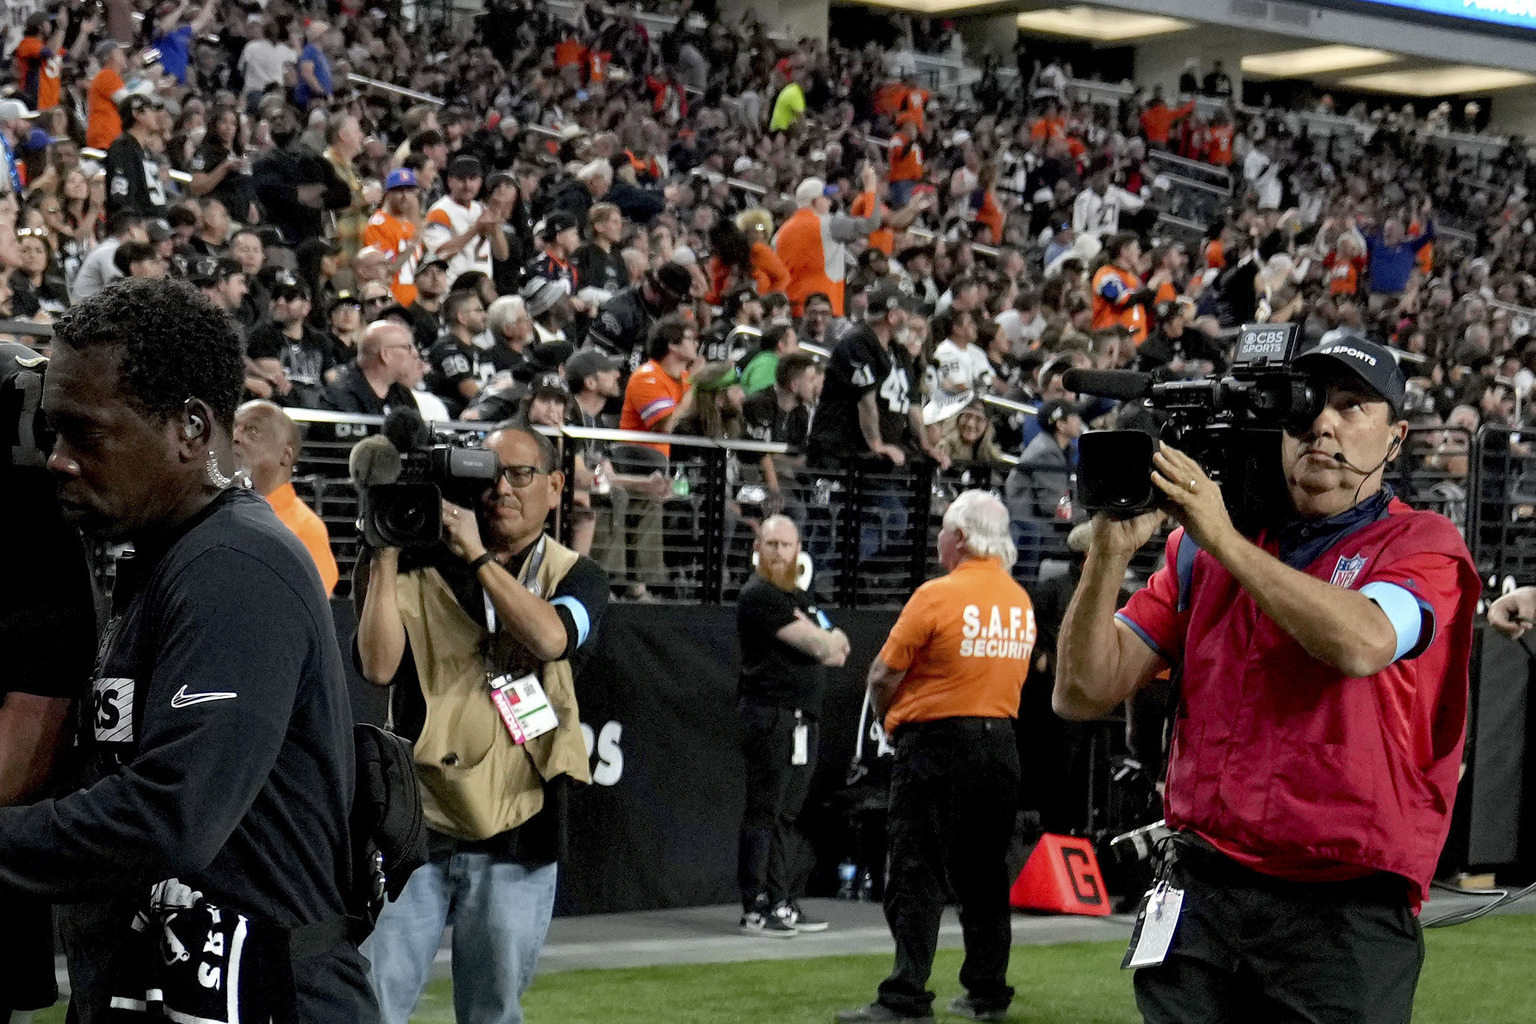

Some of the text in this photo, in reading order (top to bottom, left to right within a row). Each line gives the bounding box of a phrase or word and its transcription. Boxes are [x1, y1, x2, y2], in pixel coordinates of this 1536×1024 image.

[1242, 343, 1281, 354] SPORTS
[1254, 331, 1284, 344] CBS
[1332, 345, 1377, 367] SPORTS
[493, 693, 523, 741] MEDIA
[1061, 847, 1103, 906] G
